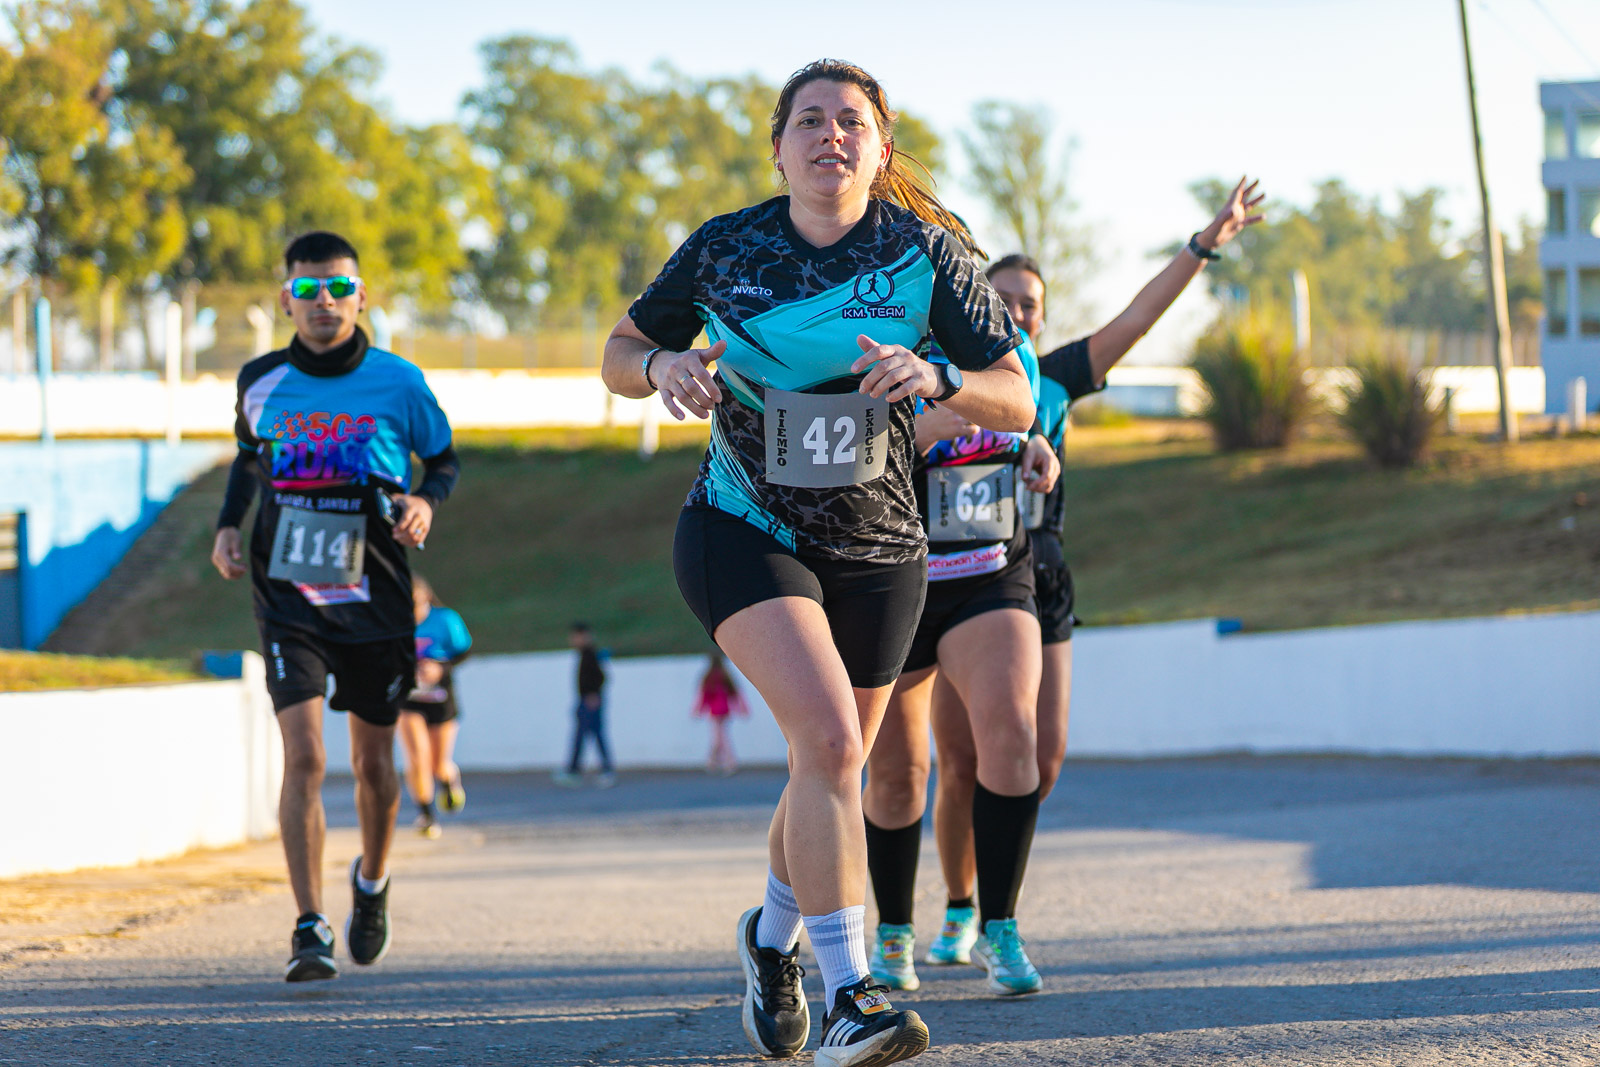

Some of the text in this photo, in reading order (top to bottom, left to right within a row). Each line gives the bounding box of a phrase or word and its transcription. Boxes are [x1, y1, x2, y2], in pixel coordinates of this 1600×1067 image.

[732, 285, 773, 297] INVICTO
[842, 305, 905, 319] KM. TEAM
[777, 408, 787, 467] TIEMPO
[802, 415, 856, 465] 42
[865, 407, 874, 465] EXACTO
[956, 481, 991, 522] 62
[288, 524, 348, 569] 114
